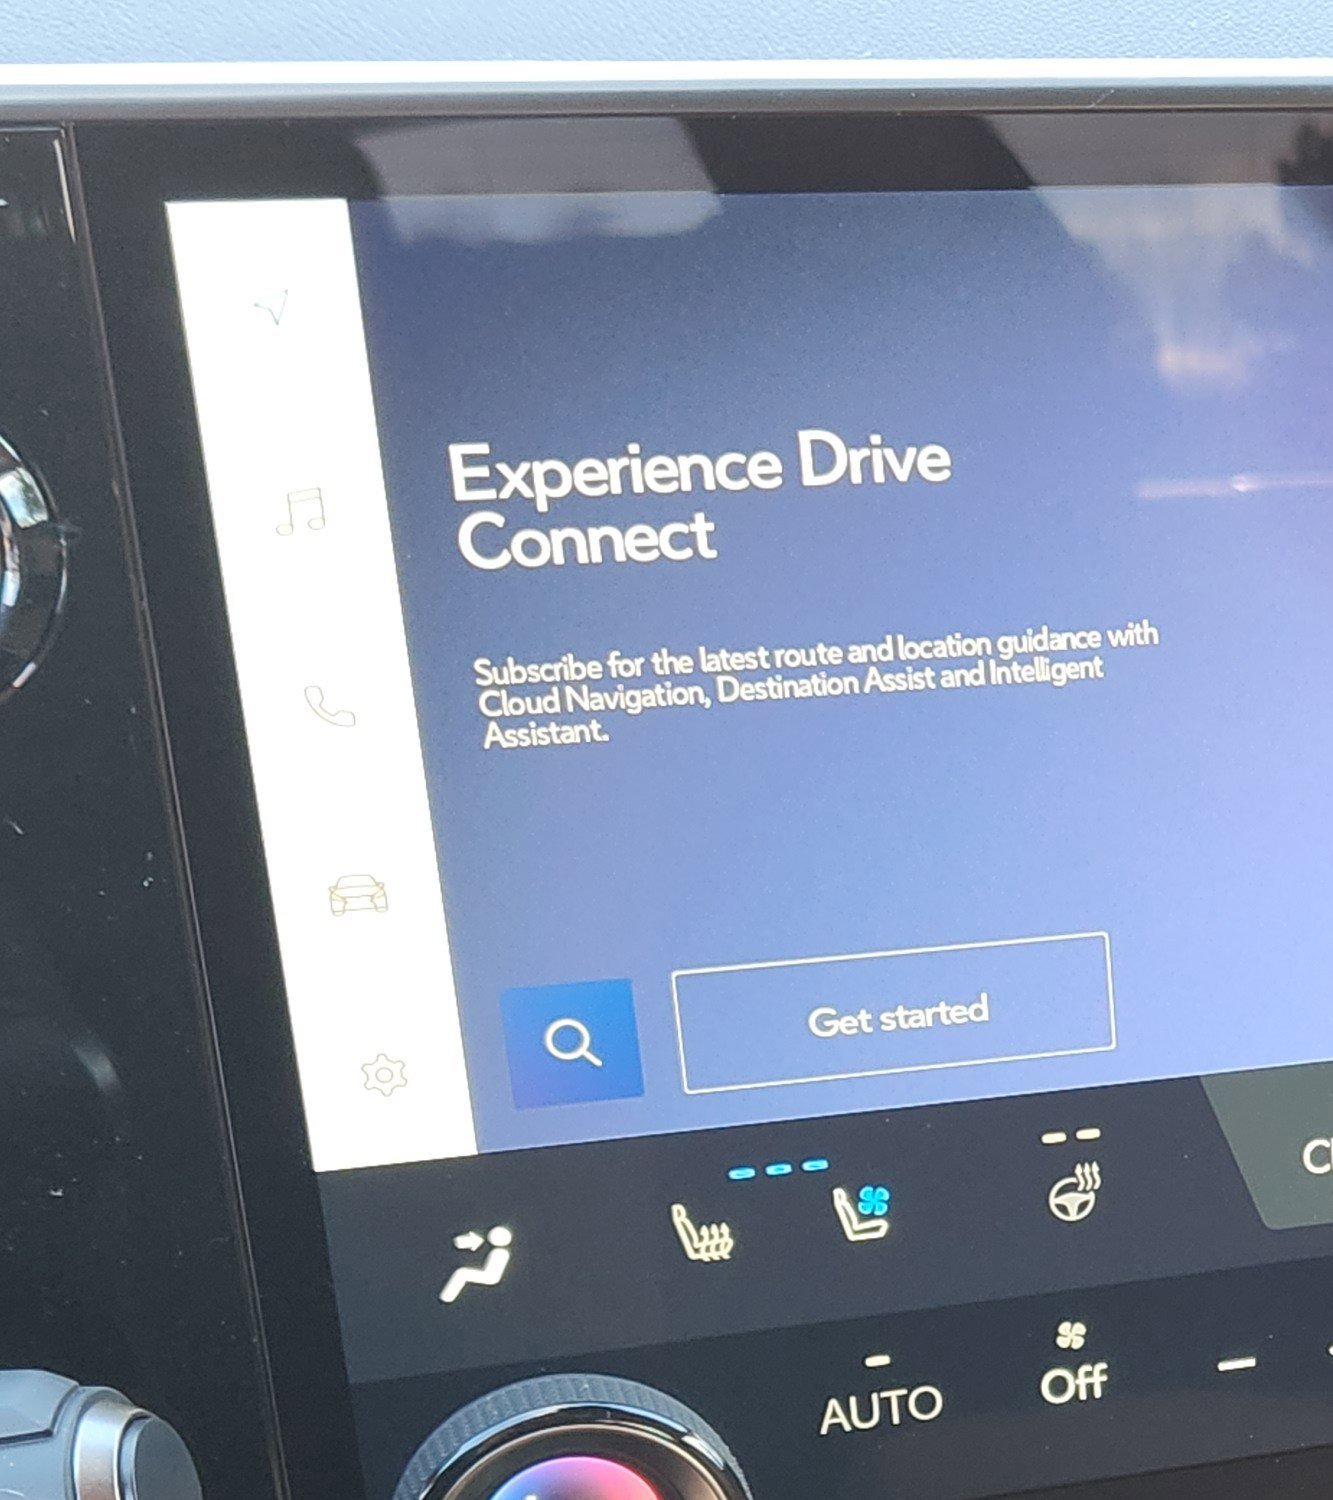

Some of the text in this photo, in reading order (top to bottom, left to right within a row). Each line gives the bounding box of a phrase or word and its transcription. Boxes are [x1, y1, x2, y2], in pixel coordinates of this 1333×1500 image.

[448, 428, 952, 513] Experience Drive
[457, 509, 718, 570] Connect
[473, 619, 1159, 686] Subscribe for the latest route and location guidance with
[478, 655, 1105, 717] Cloud Navigation, Destination Assist and Intelligent
[484, 718, 610, 749] Assistant.
[808, 993, 990, 1038] Get started
[819, 1384, 944, 1436] AUTO
[1039, 1362, 1109, 1405] Off
